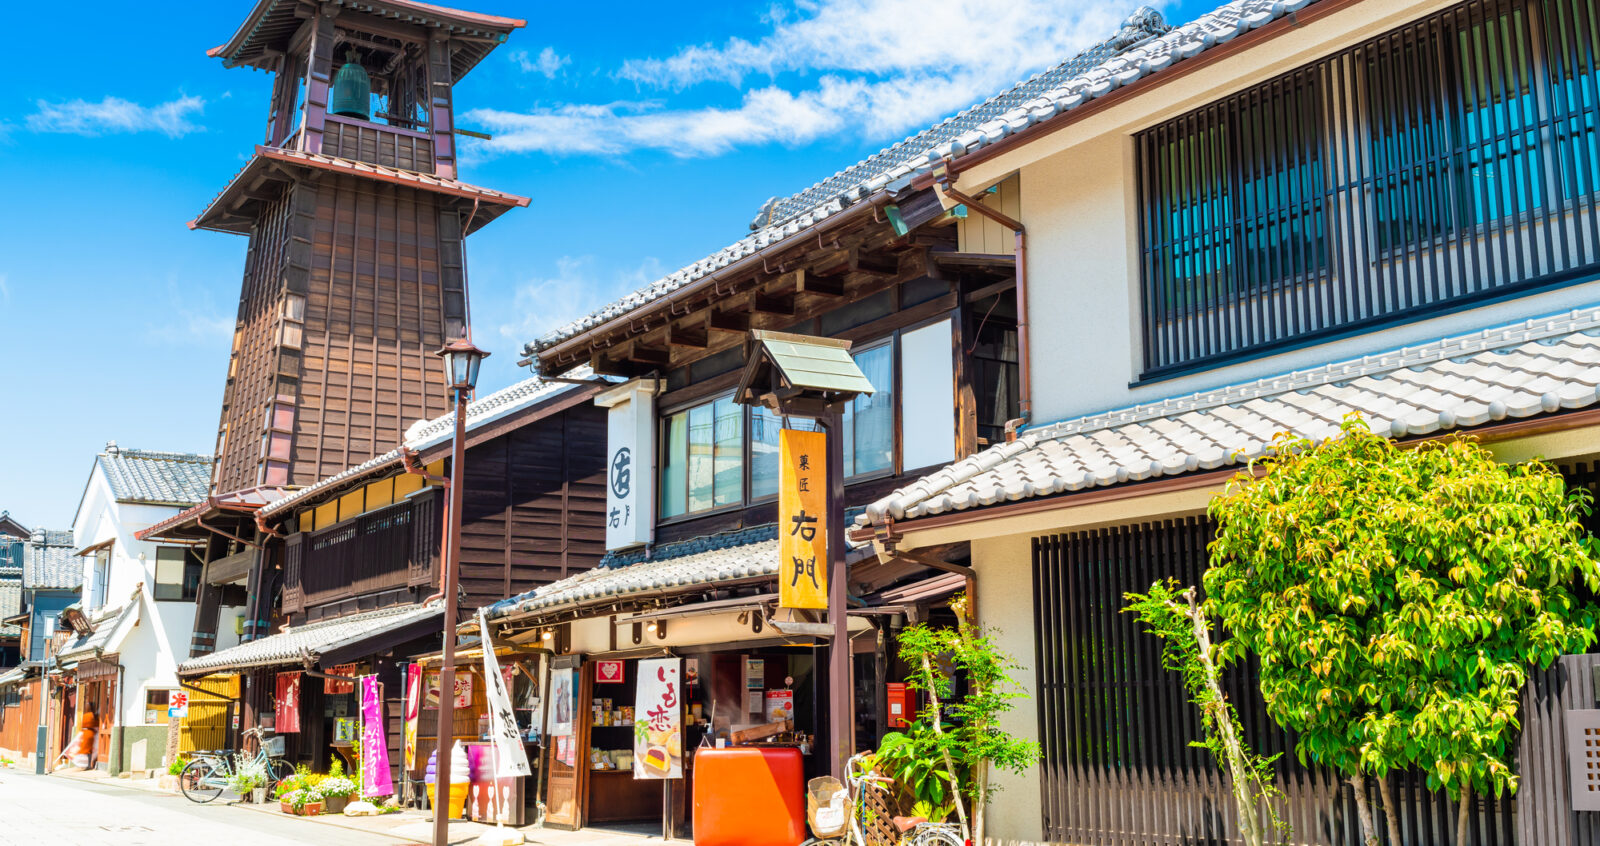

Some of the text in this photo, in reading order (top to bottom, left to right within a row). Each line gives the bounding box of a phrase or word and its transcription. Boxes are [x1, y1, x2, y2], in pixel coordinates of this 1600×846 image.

[791, 454, 819, 590] 菓匠 右門
[646, 665, 677, 732] いも恋
